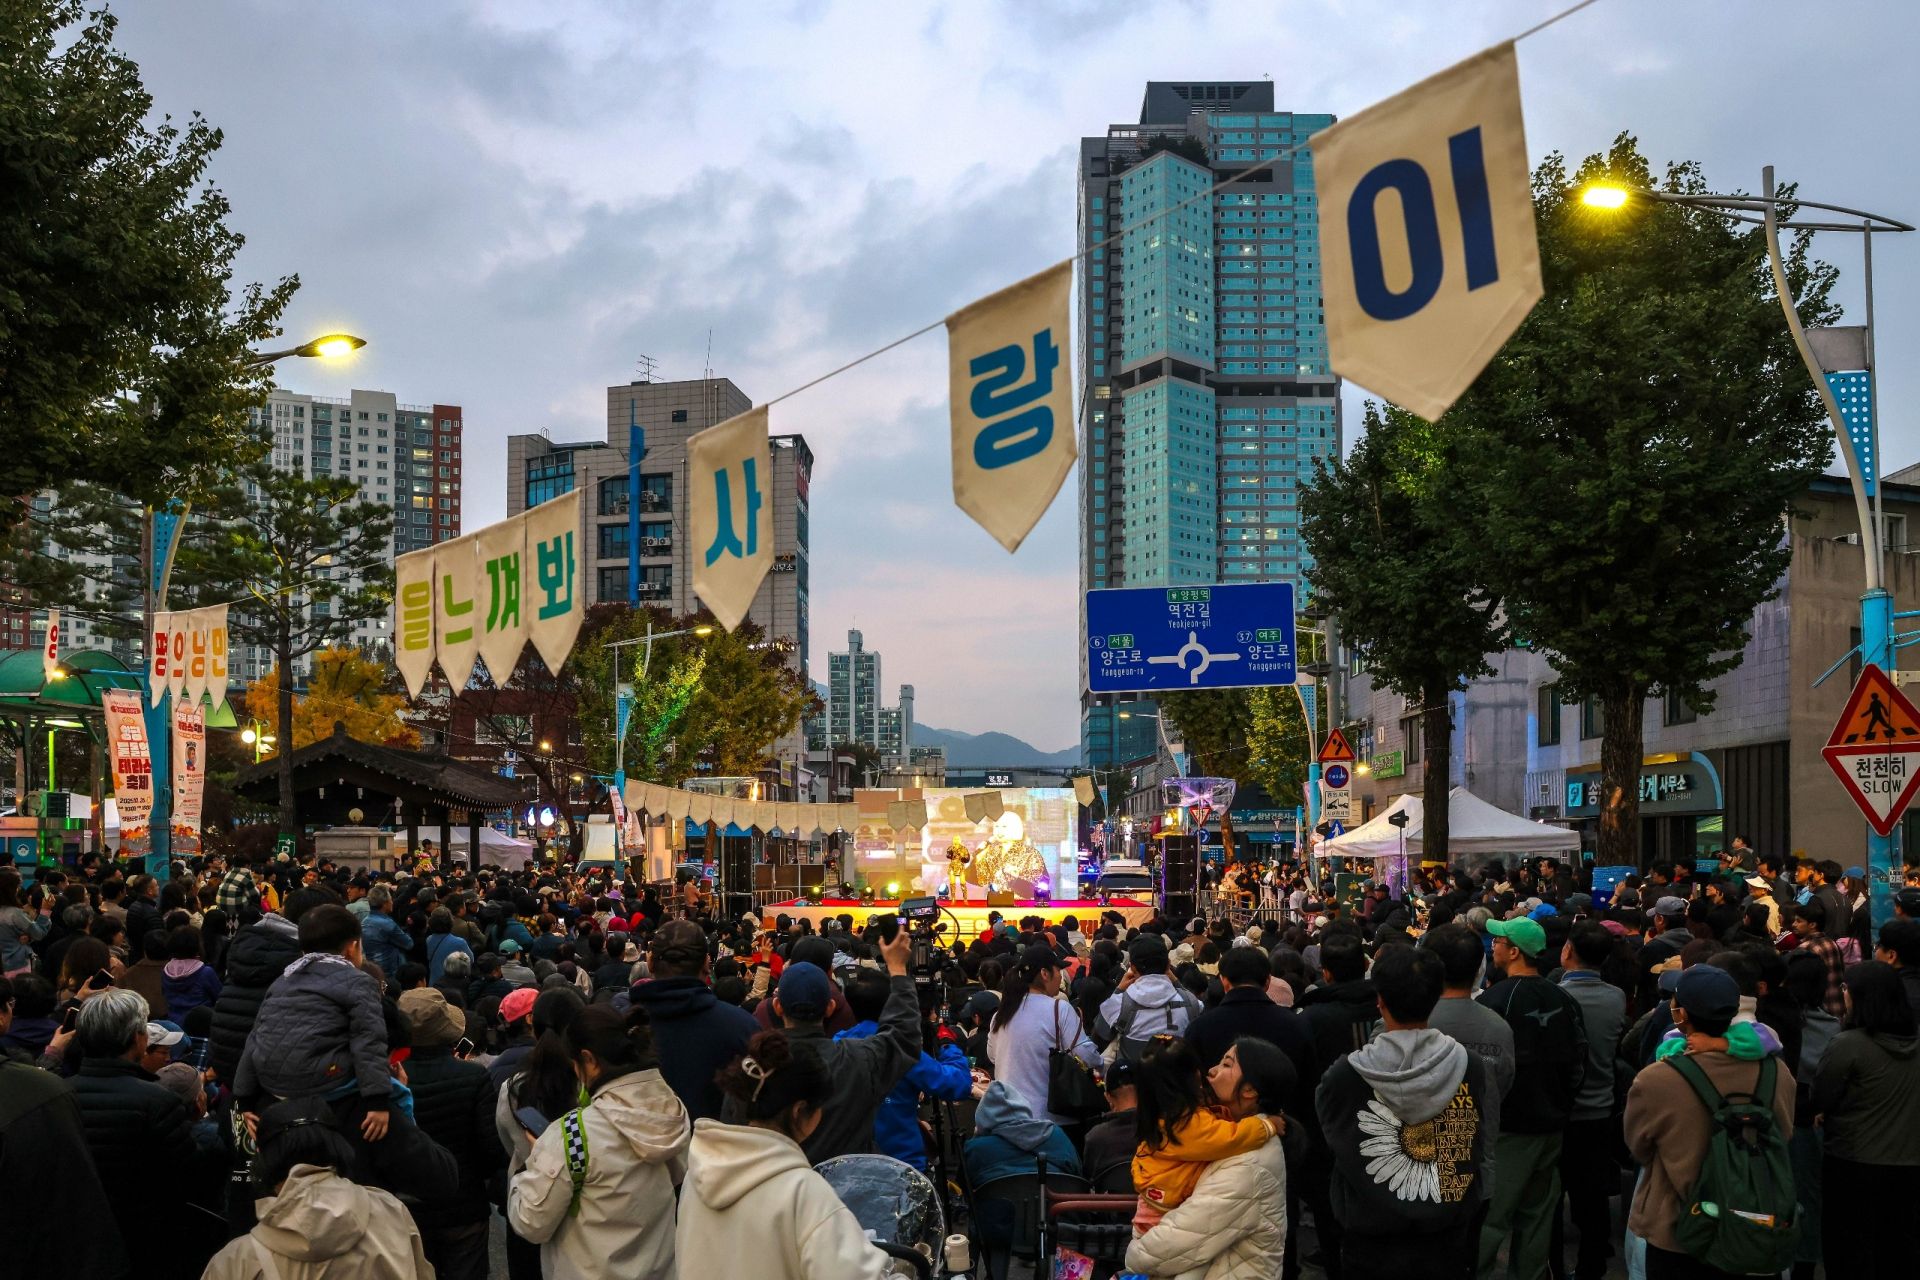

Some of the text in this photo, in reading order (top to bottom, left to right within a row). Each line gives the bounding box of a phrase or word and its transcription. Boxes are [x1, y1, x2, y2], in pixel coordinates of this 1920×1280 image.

[1346, 125, 1499, 322] 이
[969, 327, 1059, 470] 랑
[705, 456, 763, 568] 사
[1180, 589, 1210, 601] 양평역
[1168, 604, 1211, 618] 역전길
[1168, 619, 1212, 629] Yeokjeon-gil
[1094, 637, 1101, 647] 6
[1111, 636, 1131, 647] 서울
[1238, 631, 1251, 643] 37
[1258, 629, 1279, 641] 여주
[1101, 650, 1143, 666] 양근로
[1248, 644, 1290, 660] 양근로
[1101, 667, 1144, 678] Yanggeun-ro
[1248, 662, 1291, 672] Yanggeun-ro
[1856, 756, 1906, 779] 천천히
[1659, 774, 1688, 793] 사무소
[1863, 780, 1902, 794] SLOW
[1436, 1135, 1474, 1149] BEST
[1438, 1148, 1471, 1162] MAN
[1438, 1161, 1457, 1176] IS
